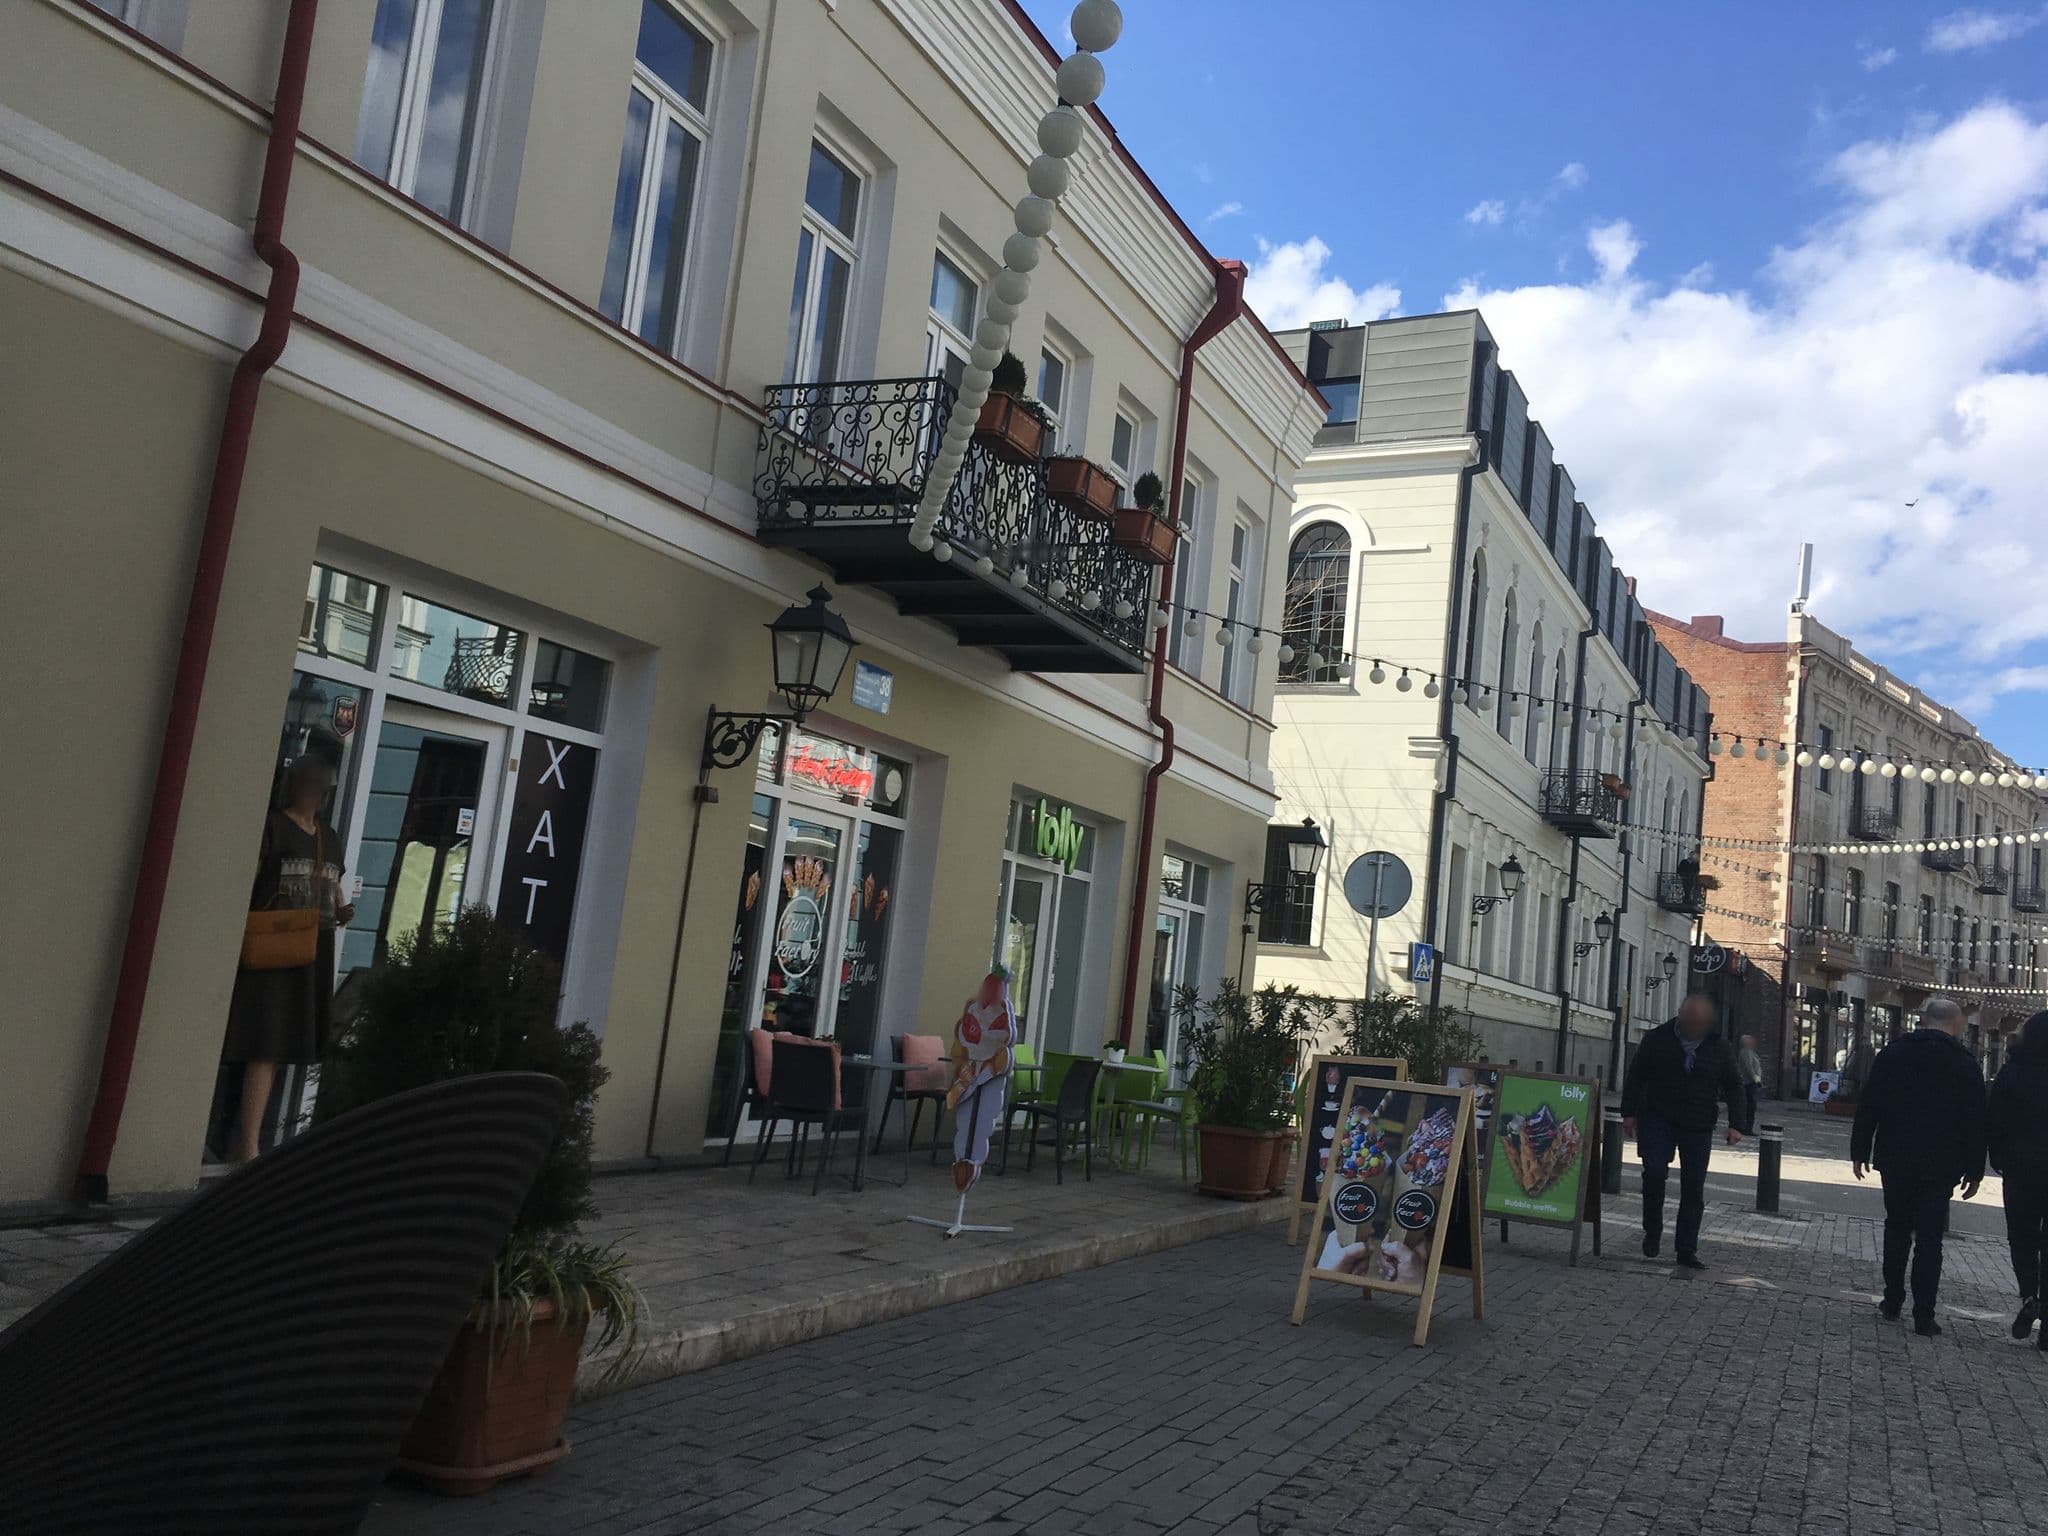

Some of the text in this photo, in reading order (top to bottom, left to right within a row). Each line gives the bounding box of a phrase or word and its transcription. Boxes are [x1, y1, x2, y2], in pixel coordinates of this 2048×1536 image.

[880, 675, 890, 697] 38
[1340, 1193, 1362, 1201] Fruit
[1400, 1198, 1422, 1208] Fruit
